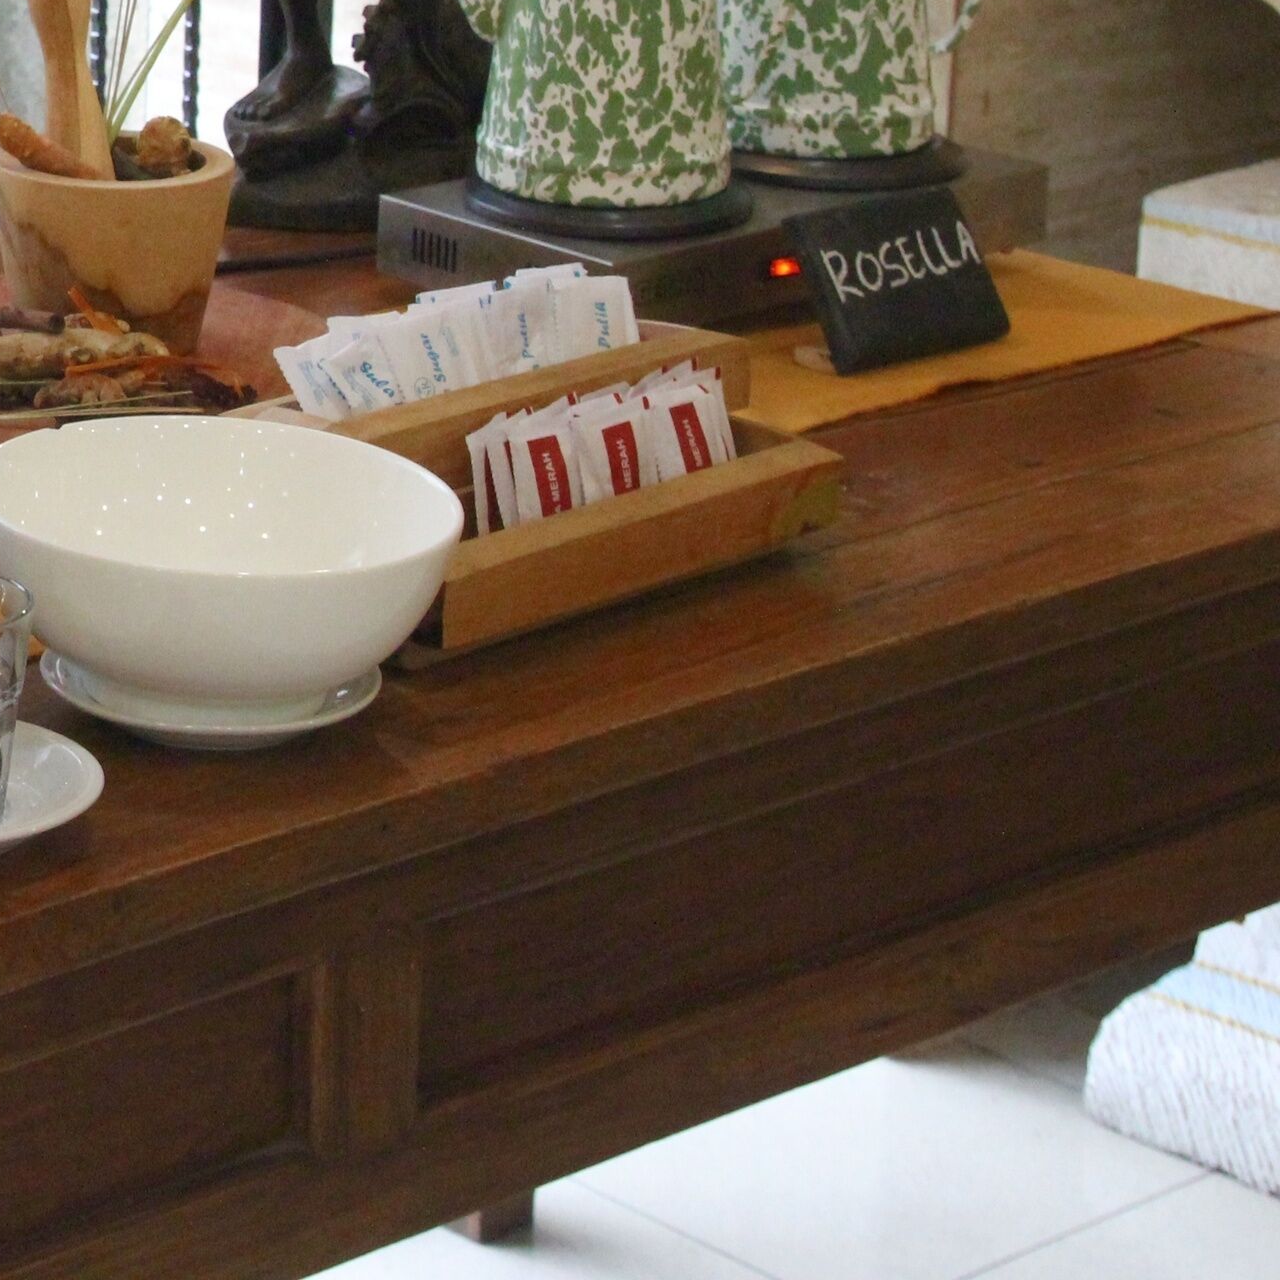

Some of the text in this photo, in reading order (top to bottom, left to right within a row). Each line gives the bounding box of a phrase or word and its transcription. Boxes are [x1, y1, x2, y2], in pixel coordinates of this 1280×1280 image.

[819, 220, 982, 304] ROSELLA
[616, 438, 632, 489] MERAH
[682, 419, 703, 468] MERAH
[541, 452, 561, 503] MERAH
